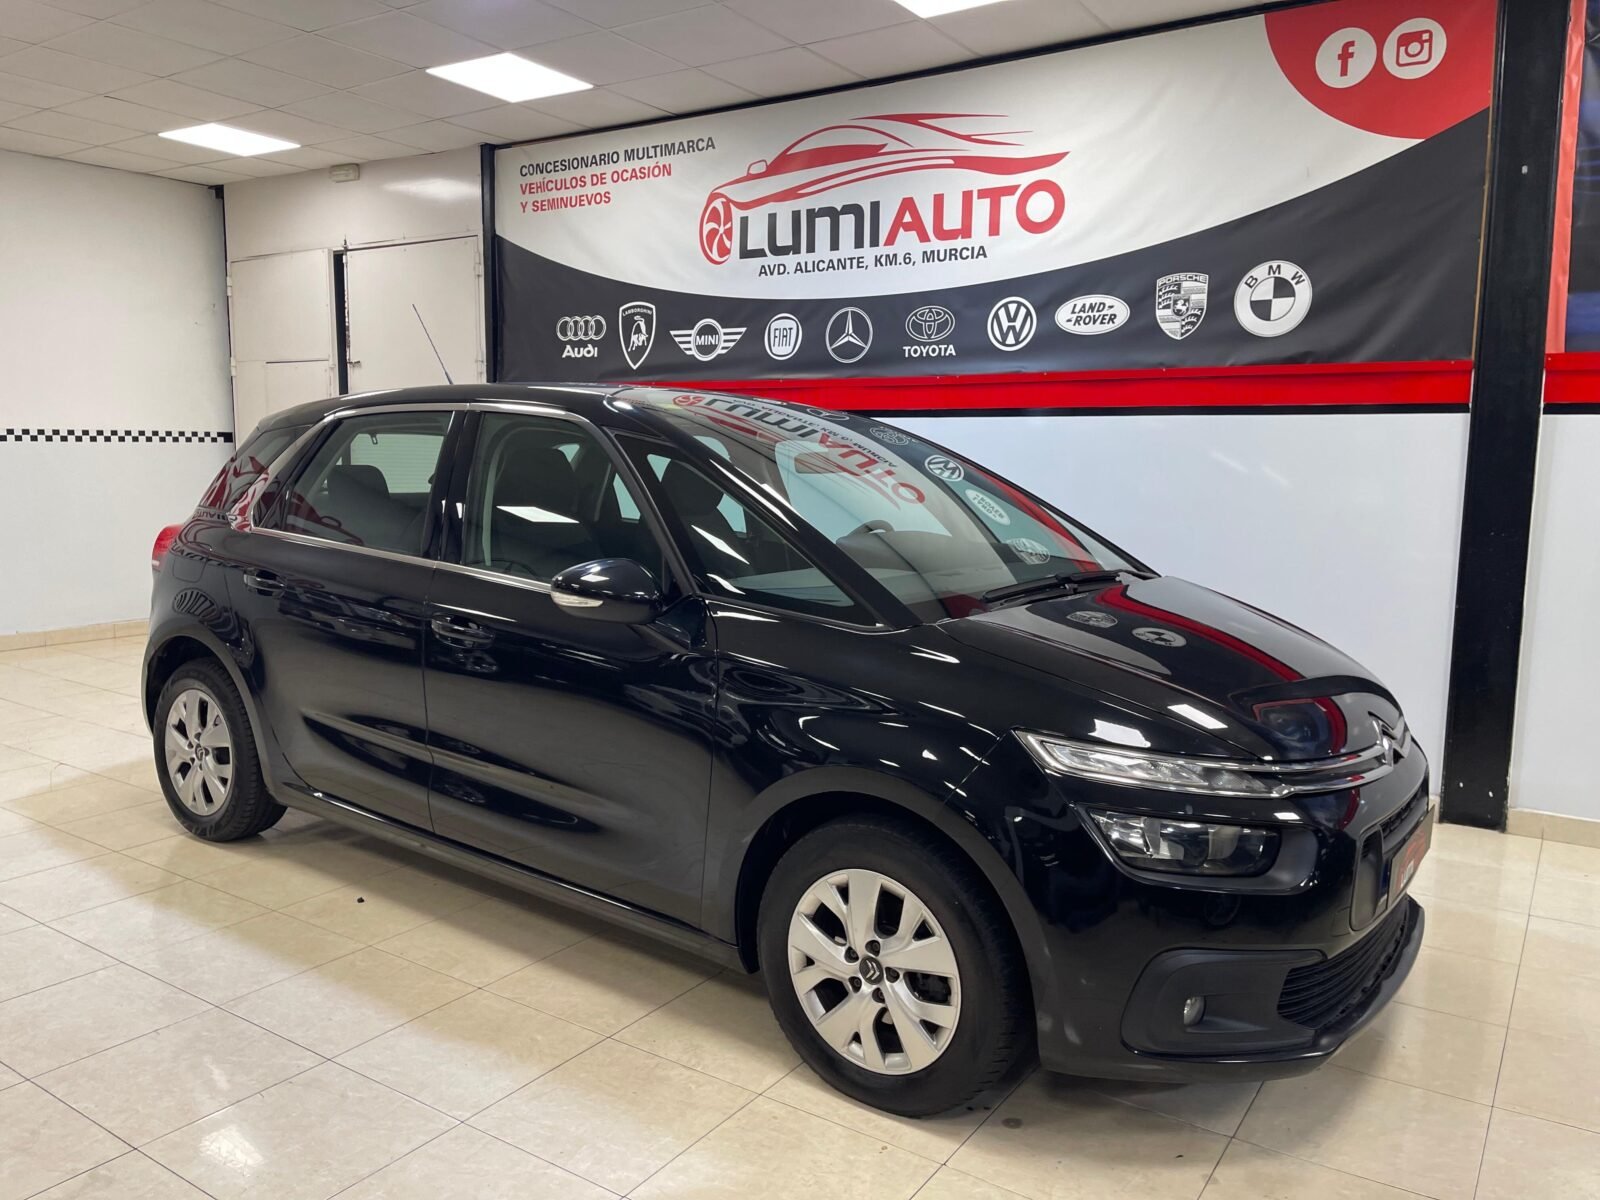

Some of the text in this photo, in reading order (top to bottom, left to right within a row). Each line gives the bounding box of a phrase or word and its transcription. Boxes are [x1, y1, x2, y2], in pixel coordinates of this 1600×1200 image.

[519, 136, 716, 177] CONCESIONARIO MULTIMARCA
[520, 161, 672, 195] VEHÍCULOS DE OCASIÓN
[520, 191, 612, 213] Y SEMINUEVOS
[758, 245, 988, 277] AVD. ALICANTE, KM.6, MURCIA
[1158, 274, 1207, 287] PORSCHE
[1244, 263, 1305, 289] BMW
[695, 334, 719, 346] MINI
[773, 327, 794, 348] FIAT
[562, 344, 598, 358] Audi
[903, 344, 957, 358] TOYOTA
